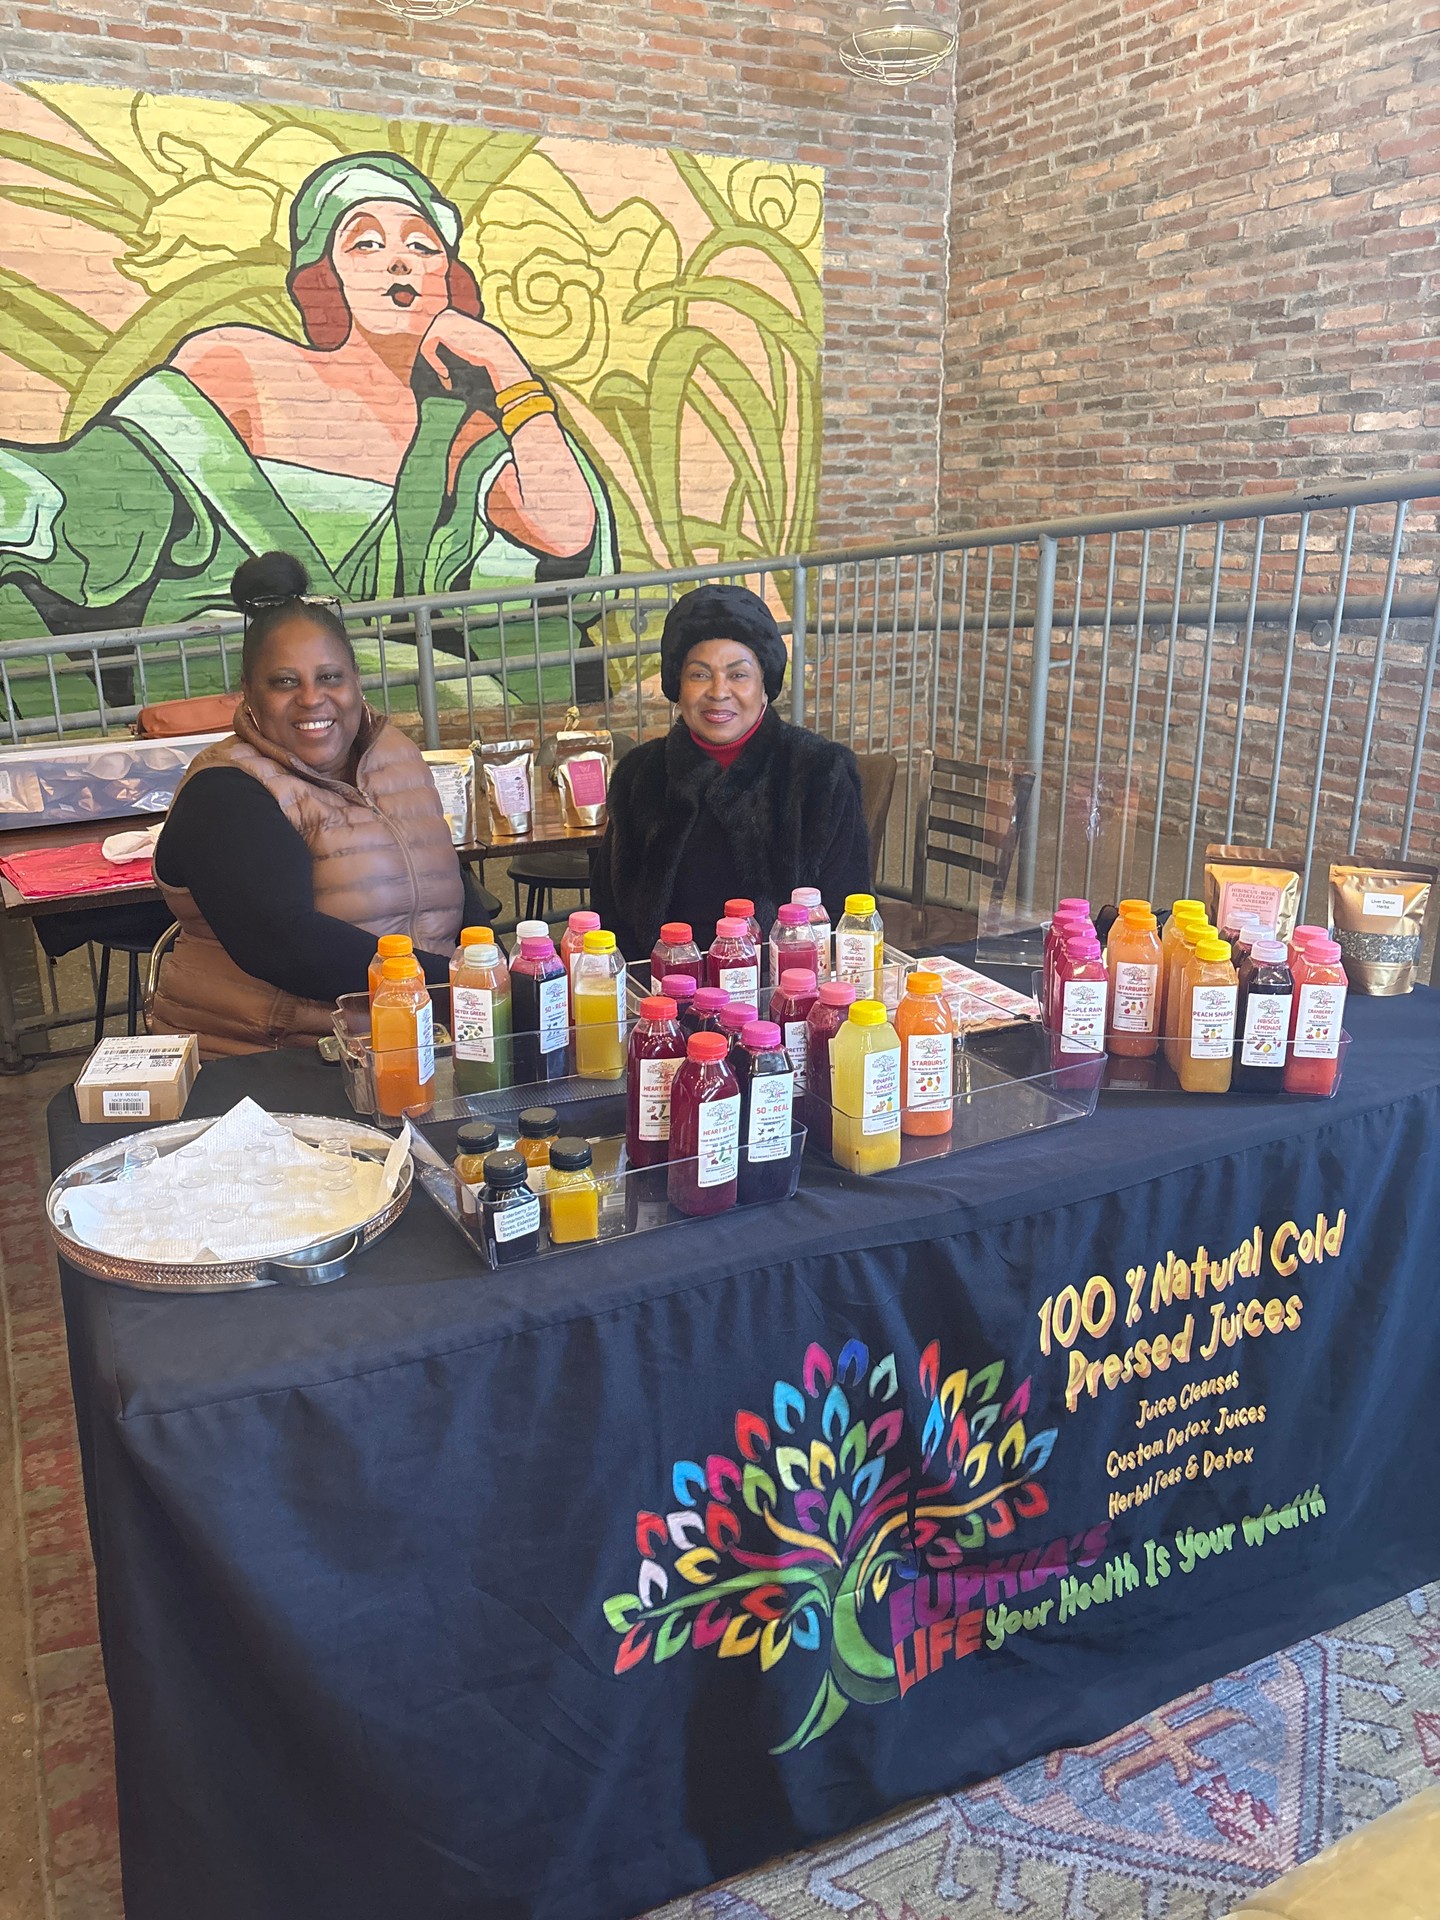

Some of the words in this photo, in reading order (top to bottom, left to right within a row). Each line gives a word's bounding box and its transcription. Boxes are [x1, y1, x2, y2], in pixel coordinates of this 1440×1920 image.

[1231, 887, 1258, 895] HIBISCUS
[1231, 892, 1274, 901] ELDERFLOWER
[1235, 897, 1270, 905] CRANBERRY
[1118, 984, 1151, 993] STARBURST
[454, 1008, 469, 1016] DETOX
[470, 1009, 486, 1017] GREEN
[1193, 1010, 1213, 1018] PEACH
[1214, 1010, 1233, 1018] SNAPS
[911, 1058, 947, 1066] STARBURST
[876, 1082, 894, 1091] GINGER
[756, 1106, 767, 1115] SO
[772, 1103, 789, 1113] REAL
[502, 1207, 527, 1219] Elderberry
[1038, 1275, 1116, 1356] 100
[1125, 1264, 1147, 1328] %
[1150, 1225, 1264, 1314] Natural
[1270, 1208, 1347, 1277] Cold
[1065, 1313, 1195, 1413] Pressed
[1199, 1294, 1303, 1361] Juices
[1135, 1395, 1177, 1429] Juice
[1179, 1370, 1240, 1410] Cleanses
[1106, 1438, 1164, 1479] Custom
[1166, 1418, 1212, 1455] Detox
[1214, 1405, 1267, 1435] Juices
[1108, 1476, 1153, 1520] Herbal
[1153, 1465, 1182, 1496] Teas
[1184, 1454, 1200, 1481] &
[1203, 1446, 1255, 1478] Detox
[985, 1598, 1054, 1650] Your
[1058, 1551, 1140, 1625] Health
[1143, 1538, 1171, 1588] Is
[1174, 1525, 1237, 1574] Your
[894, 1608, 985, 1700] LIFE
